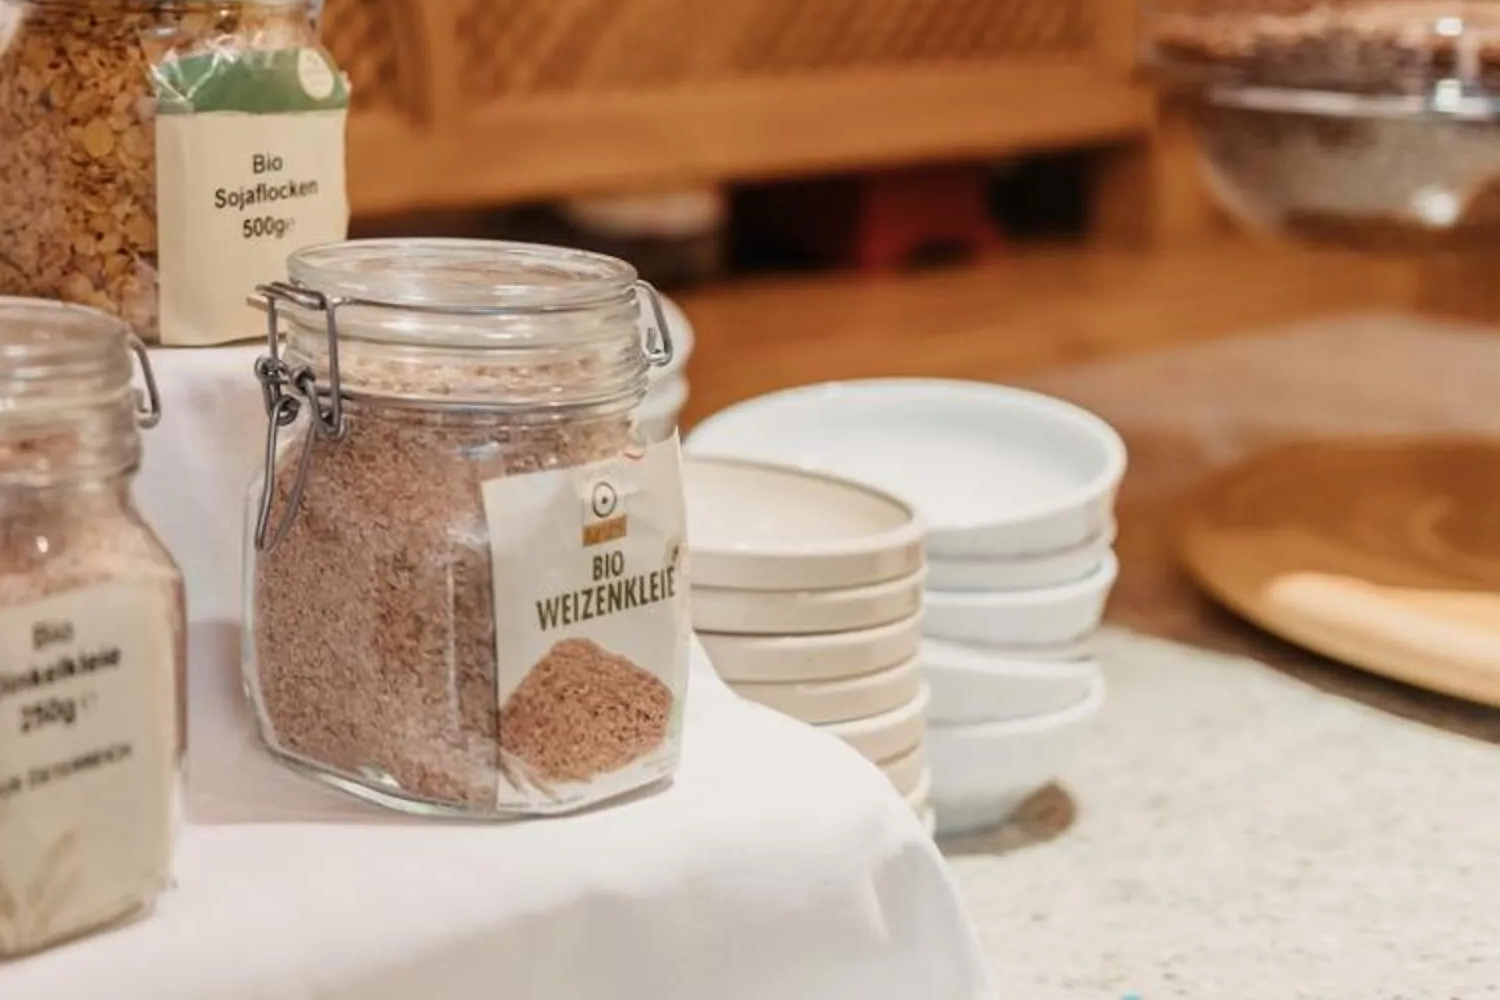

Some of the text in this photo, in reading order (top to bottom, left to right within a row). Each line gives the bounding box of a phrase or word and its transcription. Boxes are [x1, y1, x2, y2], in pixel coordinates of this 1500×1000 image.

[252, 151, 283, 175] Bio
[214, 179, 319, 212] Sojaflocken
[242, 215, 285, 239] 500g
[592, 550, 625, 582] BIO
[535, 566, 677, 633] WEIZENKLEIE
